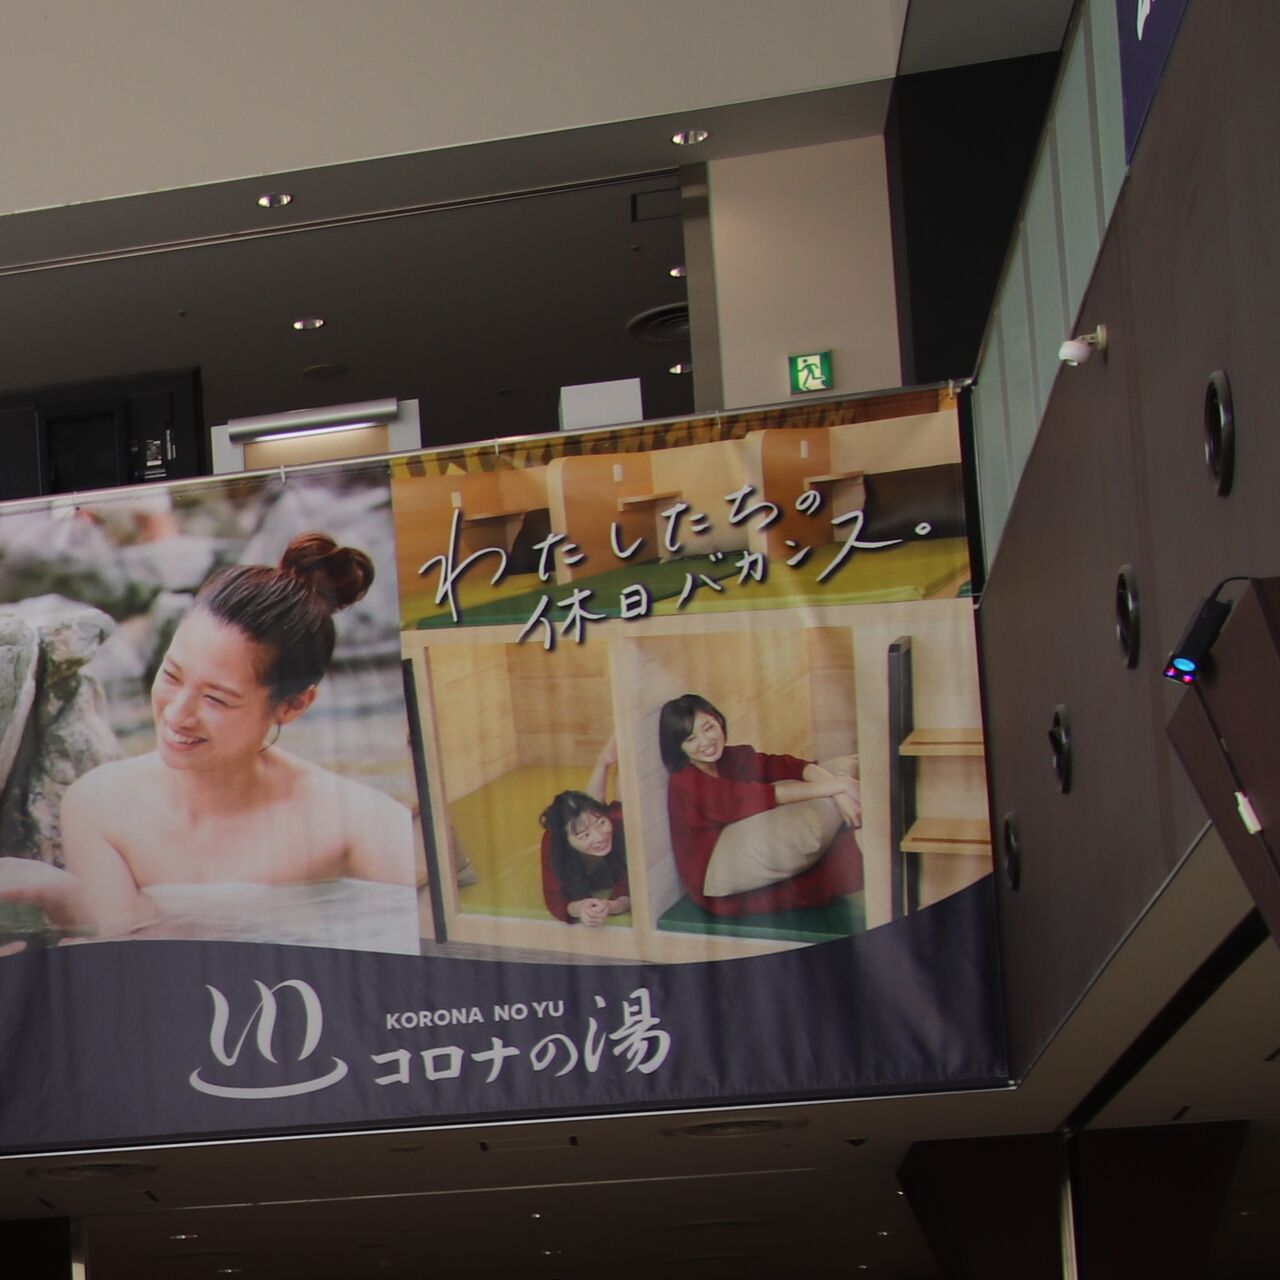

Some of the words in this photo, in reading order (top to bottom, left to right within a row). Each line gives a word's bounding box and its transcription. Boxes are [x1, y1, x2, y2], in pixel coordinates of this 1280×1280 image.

[418, 484, 822, 623] わたしたちの
[370, 986, 672, 1087] コロナの湯
[386, 1006, 484, 1030] KORONA
